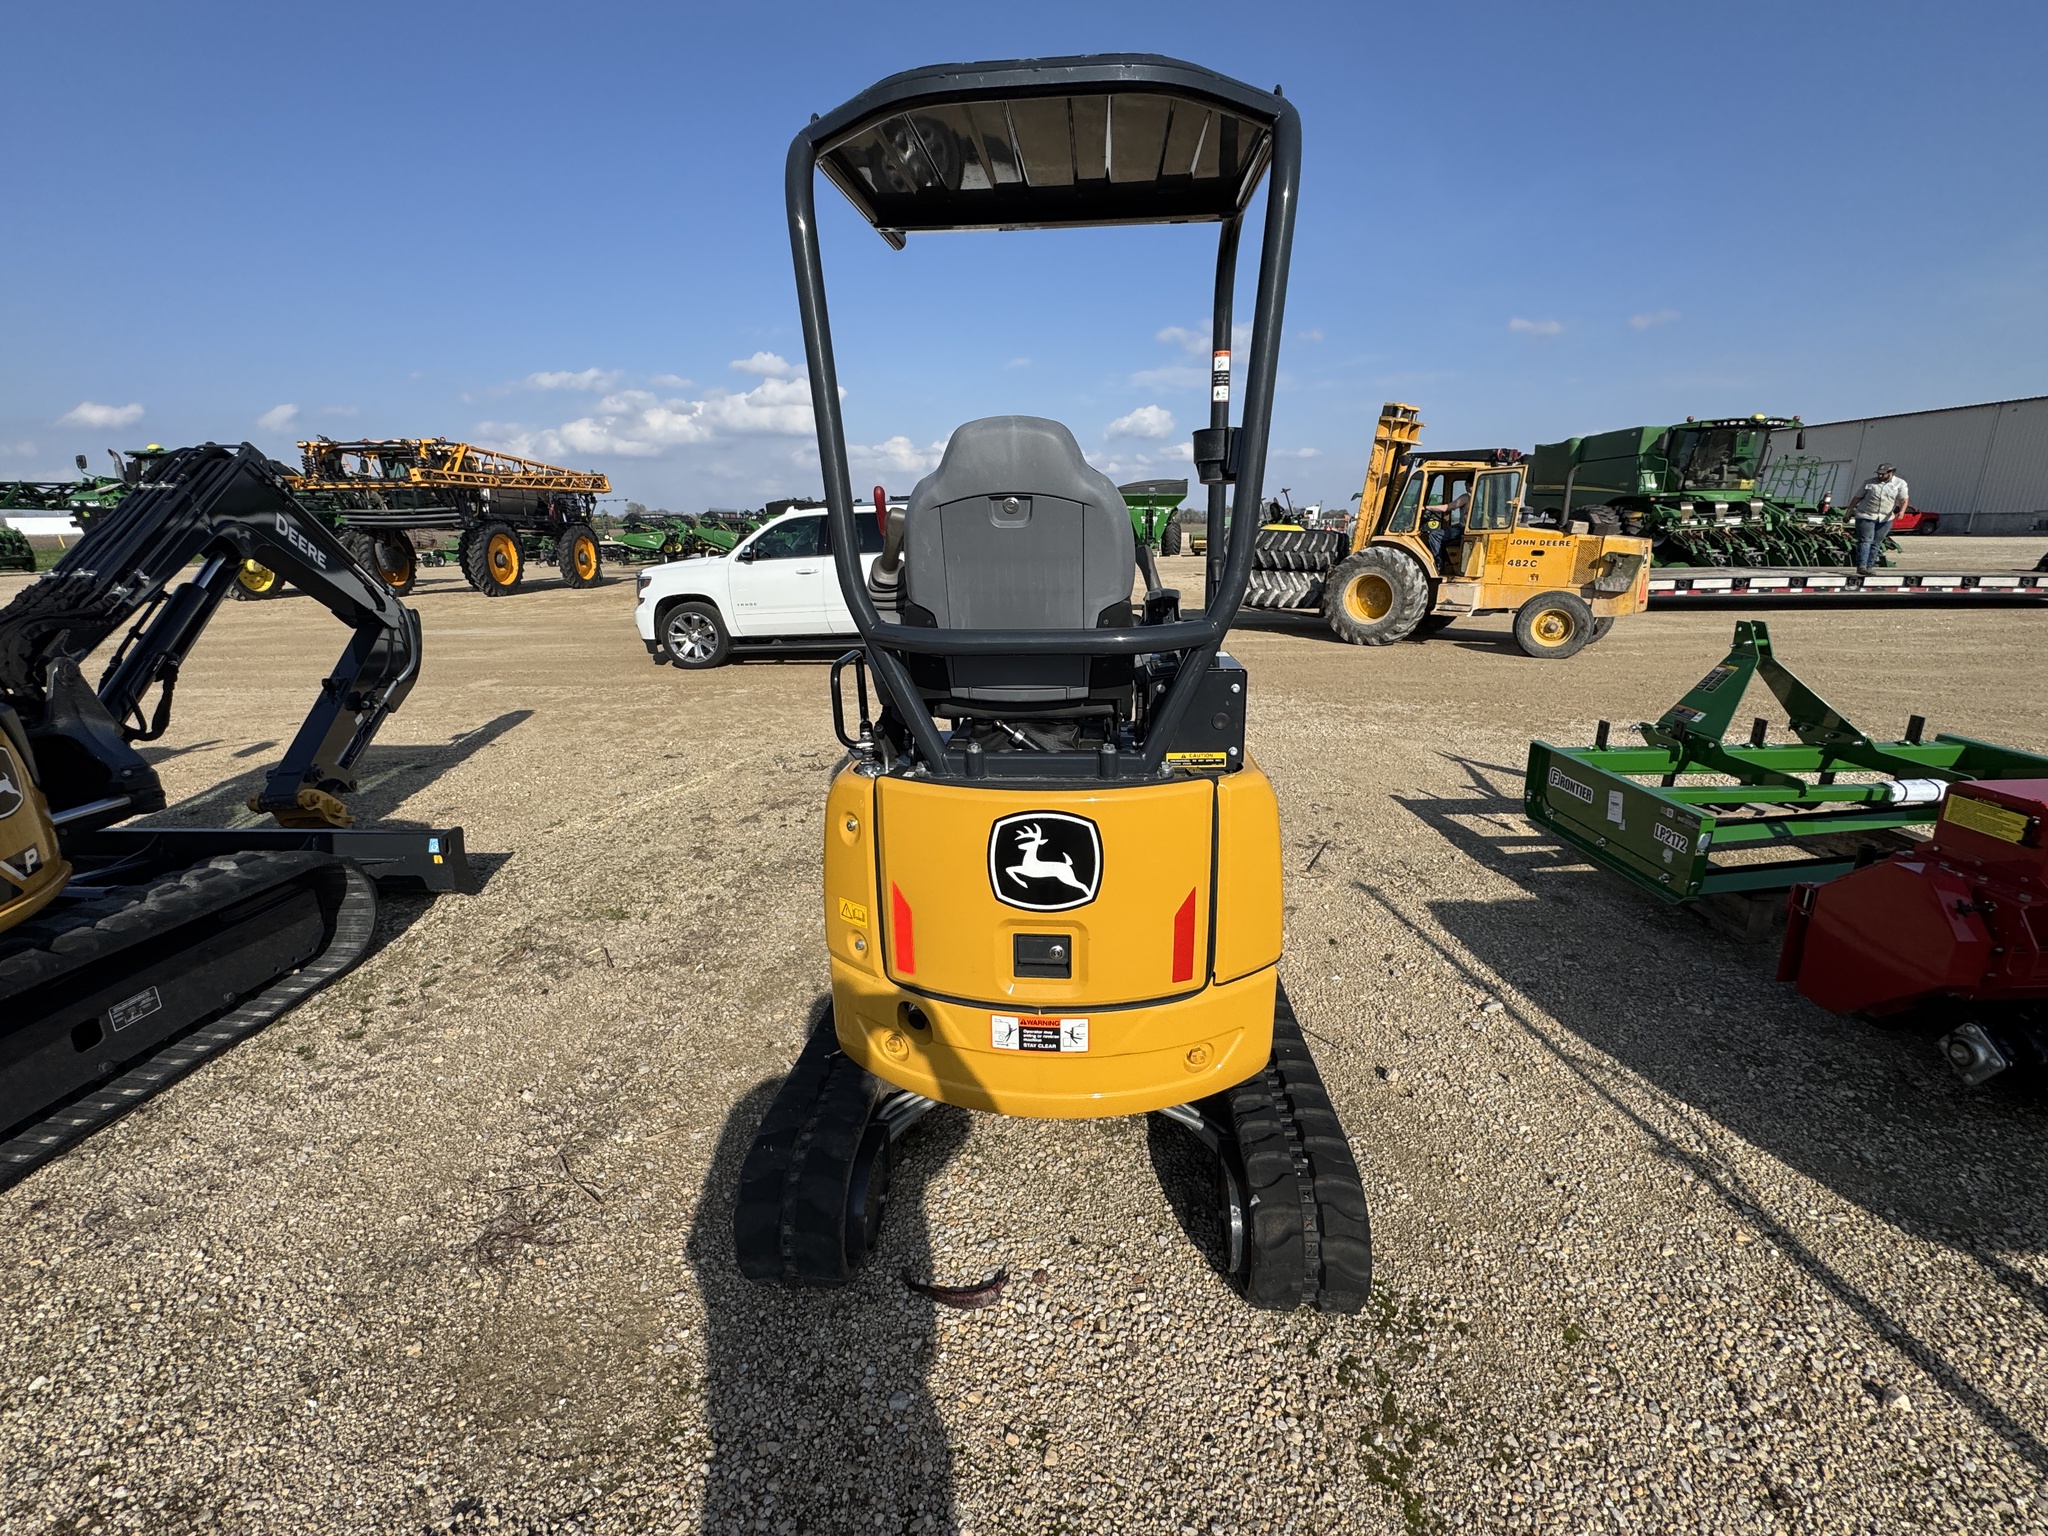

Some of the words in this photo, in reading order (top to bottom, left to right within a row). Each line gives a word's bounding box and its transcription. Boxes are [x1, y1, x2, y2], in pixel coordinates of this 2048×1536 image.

[275, 512, 327, 570] DEERE
[1507, 559, 1538, 568] 482C
[1549, 768, 1593, 803] FRONTIER
[1654, 823, 1688, 853] LP2172
